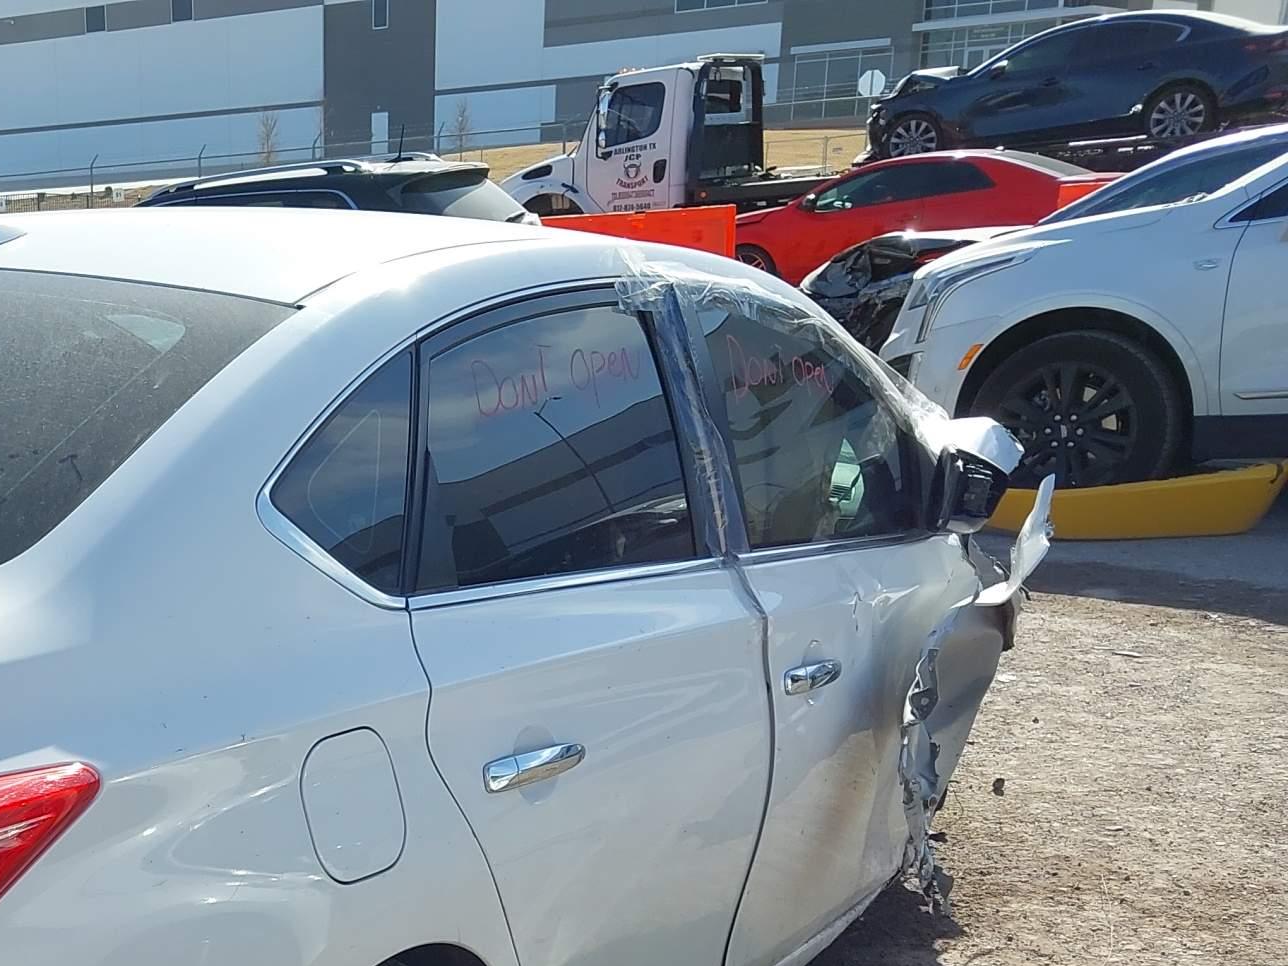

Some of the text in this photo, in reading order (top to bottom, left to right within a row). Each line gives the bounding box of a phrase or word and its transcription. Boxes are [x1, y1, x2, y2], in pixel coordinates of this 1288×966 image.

[614, 142, 657, 155] ARLINGTON TX
[615, 175, 649, 189] TRANSPORT
